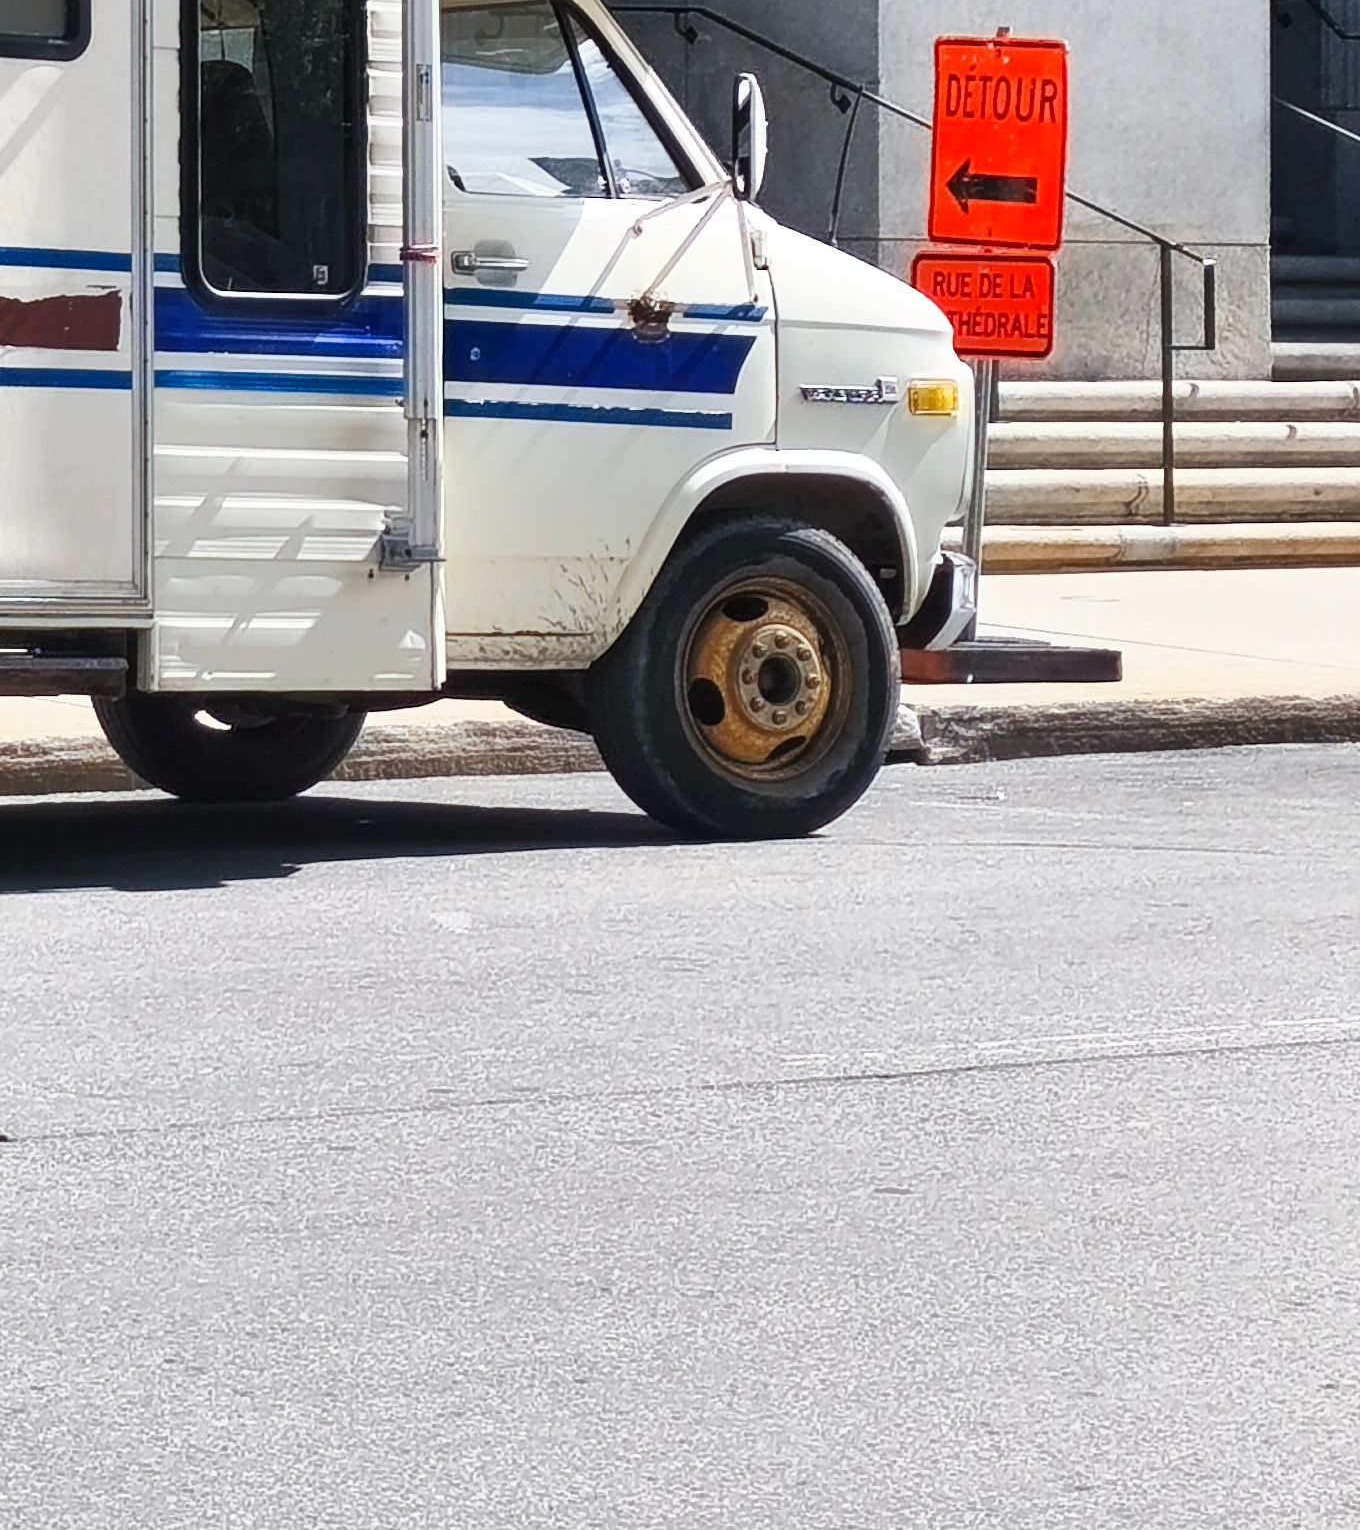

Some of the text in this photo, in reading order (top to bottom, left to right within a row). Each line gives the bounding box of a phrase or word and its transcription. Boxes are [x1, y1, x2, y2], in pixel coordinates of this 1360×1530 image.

[945, 64, 1058, 123] DÉTOUR
[932, 271, 1036, 299] RUE DE LA
[945, 306, 1049, 339] THÉDRALE
